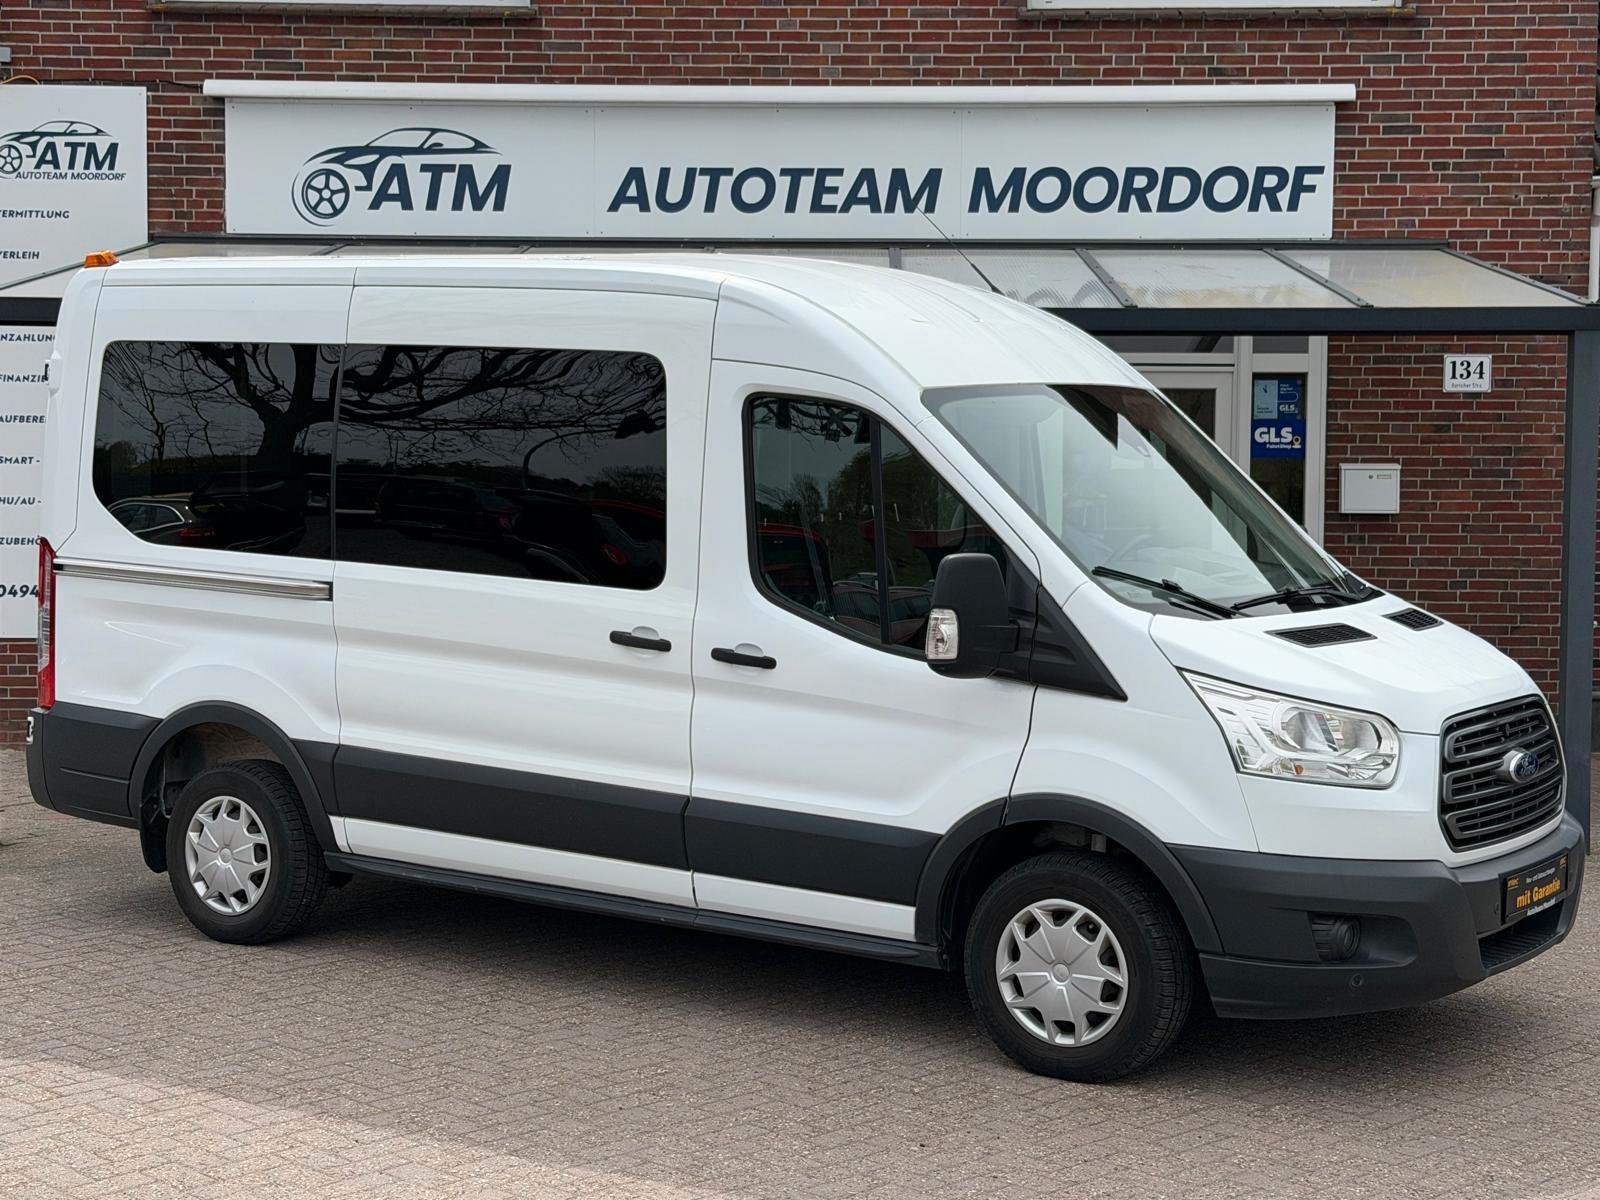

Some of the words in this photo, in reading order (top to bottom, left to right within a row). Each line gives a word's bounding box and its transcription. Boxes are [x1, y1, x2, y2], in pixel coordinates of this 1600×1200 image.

[33, 141, 119, 171] ATM
[15, 171, 68, 180] AUTOTEAM
[70, 172, 127, 181] MOORDORF
[367, 163, 512, 212] ATM
[607, 165, 943, 214] AUTOTEAM
[968, 165, 1326, 214] MOORDORF
[0, 333, 56, 343] NZAHLUN
[1449, 360, 1486, 380] 134
[1279, 404, 1295, 412] GLS
[0, 415, 46, 424] AUFBERE
[1254, 427, 1293, 443] GLS
[1516, 890, 1531, 908] mit
[1532, 877, 1561, 903] Garantie
